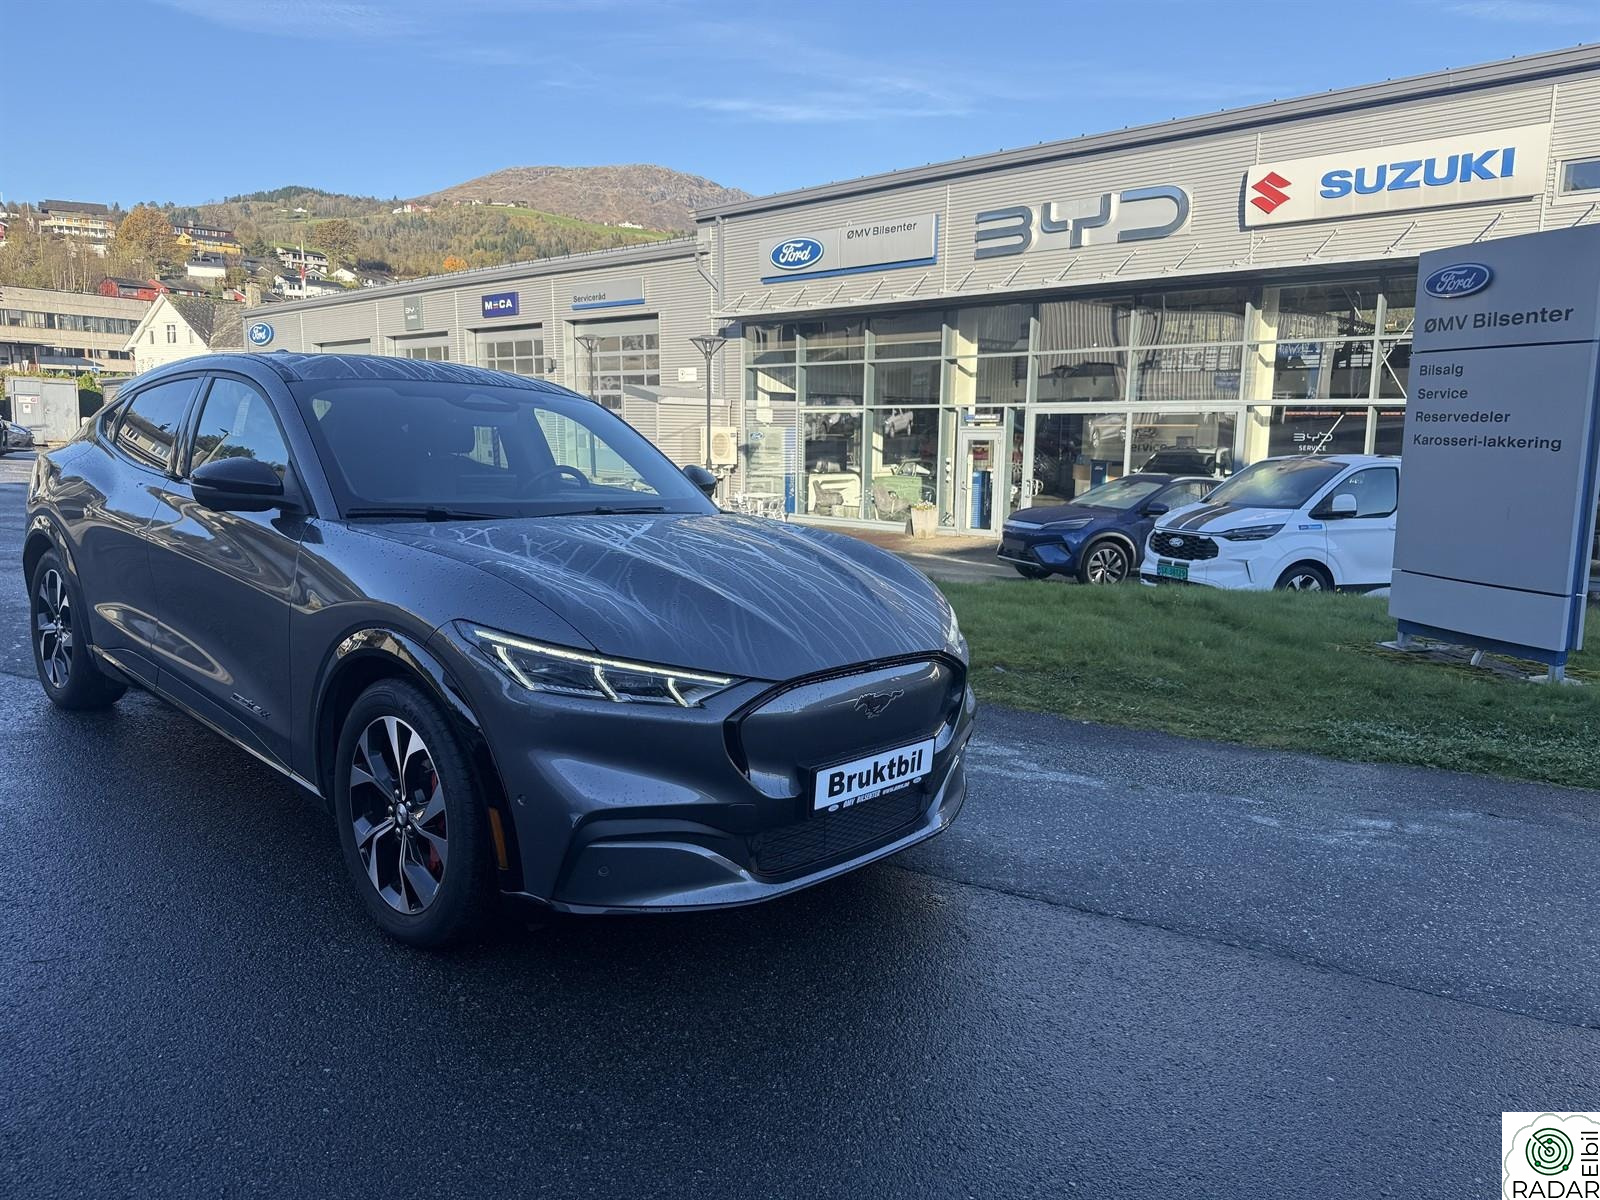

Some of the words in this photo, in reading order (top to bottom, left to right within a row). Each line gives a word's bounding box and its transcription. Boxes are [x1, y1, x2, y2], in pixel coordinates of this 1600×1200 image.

[1319, 147, 1516, 199] SUZUKI
[846, 229, 872, 240] ØMV
[873, 222, 918, 236] Bilsenter
[974, 184, 1191, 260] BYD
[779, 242, 812, 264] Ford
[1436, 269, 1476, 293] Ford
[573, 293, 606, 303] Serviceråd
[1423, 315, 1468, 333] ØMV
[1473, 307, 1574, 329] Bilsenter
[1419, 363, 1464, 377] Bilsalg
[1417, 388, 1468, 400] Service
[1415, 411, 1511, 423] Reservedeler
[1293, 432, 1333, 442] BYD
[1413, 434, 1562, 452] Karosseri-lakkering
[1130, 443, 1168, 453] ervice
[1298, 444, 1327, 452] SERVICE
[827, 749, 924, 798] Bruktbil
